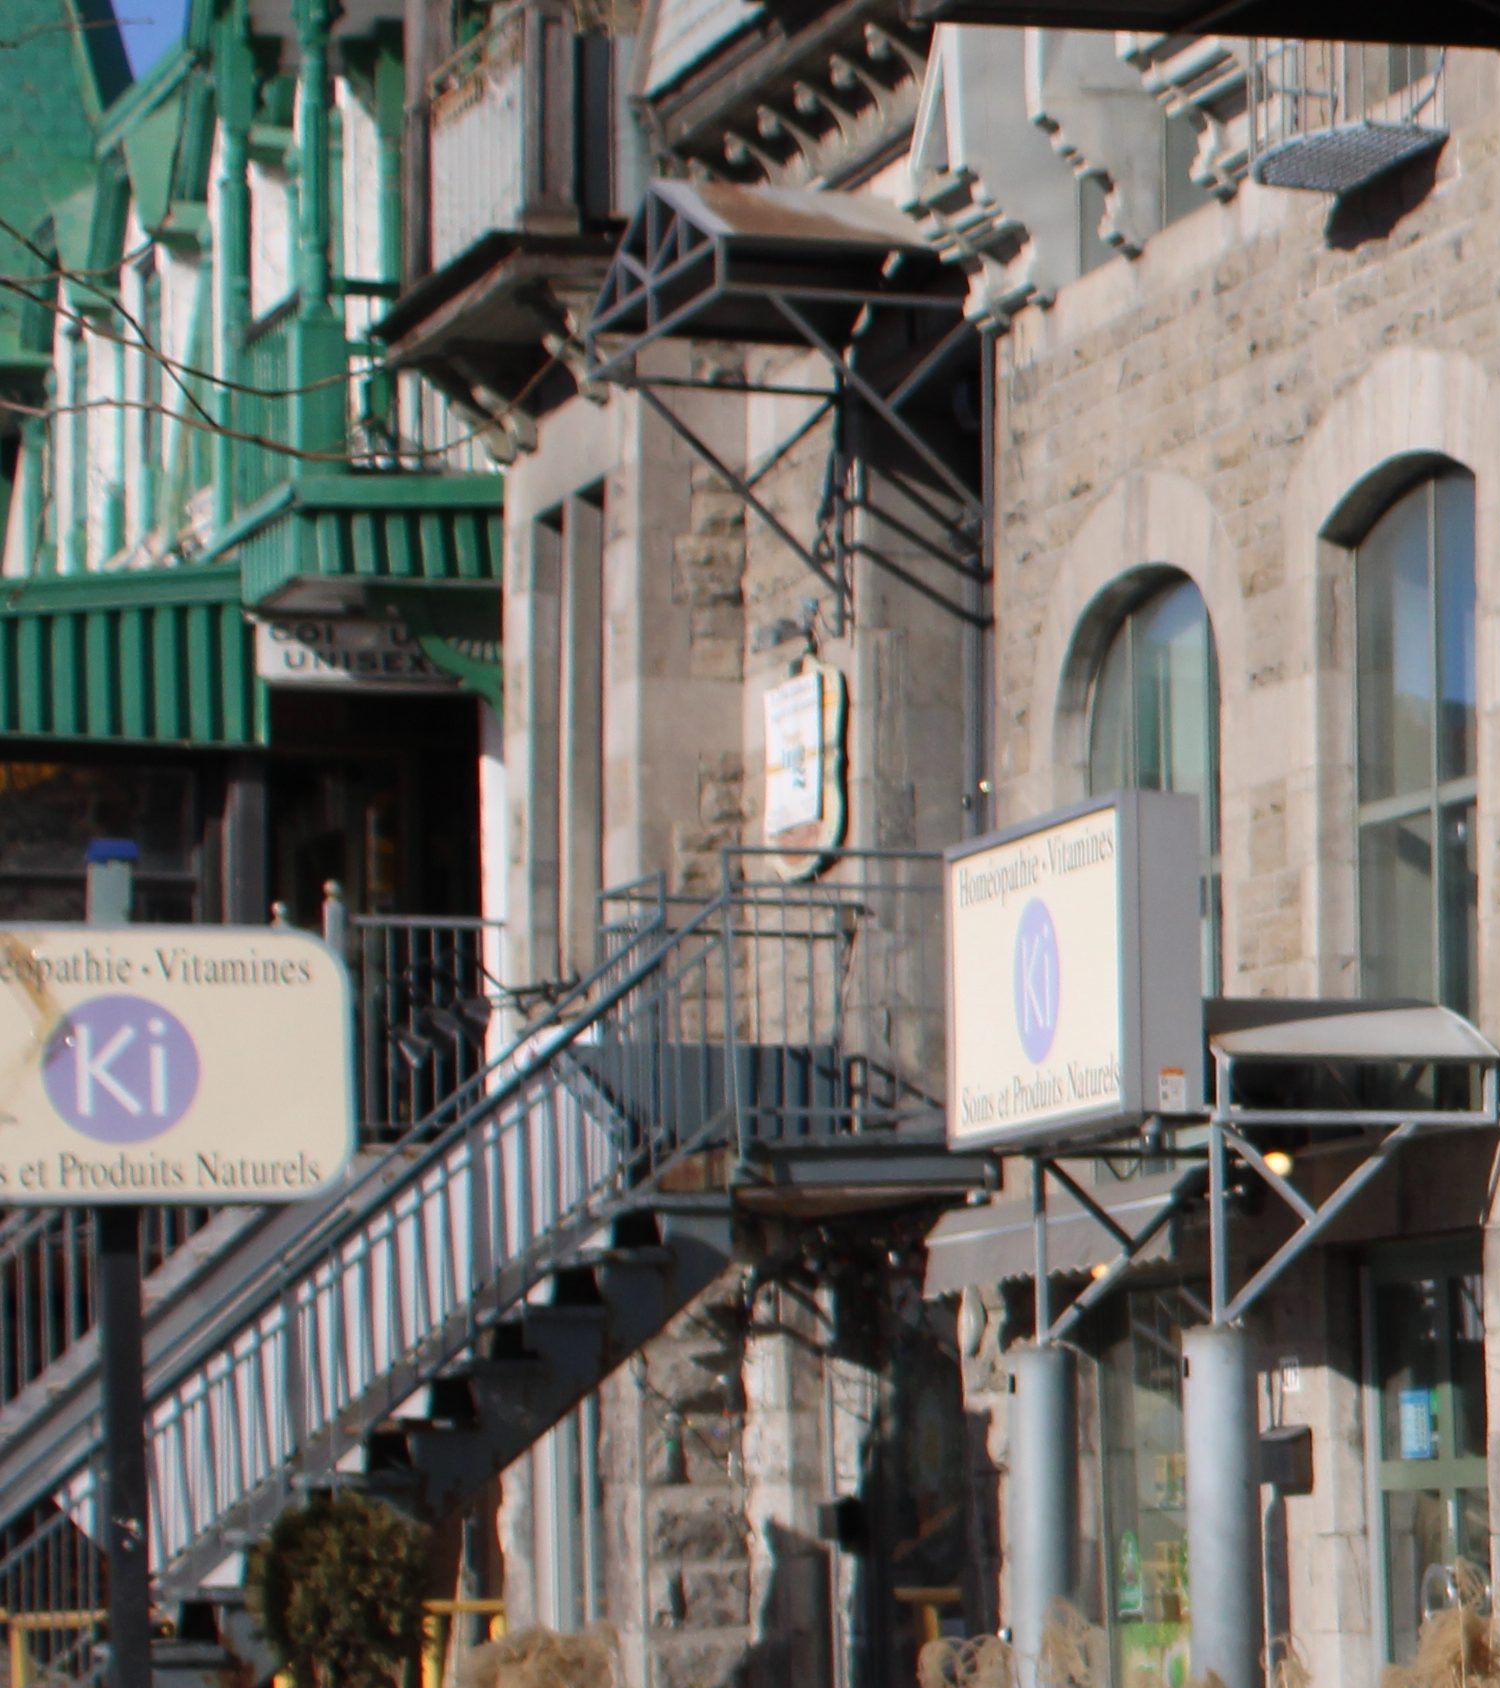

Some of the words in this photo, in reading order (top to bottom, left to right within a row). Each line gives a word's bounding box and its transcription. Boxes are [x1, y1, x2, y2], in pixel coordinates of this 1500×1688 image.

[958, 845, 1039, 909] Homéopathie
[1047, 827, 1115, 876] Vitamines
[154, 947, 311, 985] Vitamines
[1021, 922, 1051, 1035] Ki
[73, 1016, 170, 1118] Ki
[961, 1083, 994, 1126] Soins
[997, 1086, 1011, 1120] et
[1013, 1072, 1063, 1117] Produits
[1066, 1052, 1121, 1103] Naturels
[19, 1156, 46, 1188] et
[58, 1150, 184, 1188] Produits
[195, 1150, 322, 1187] Naturels
